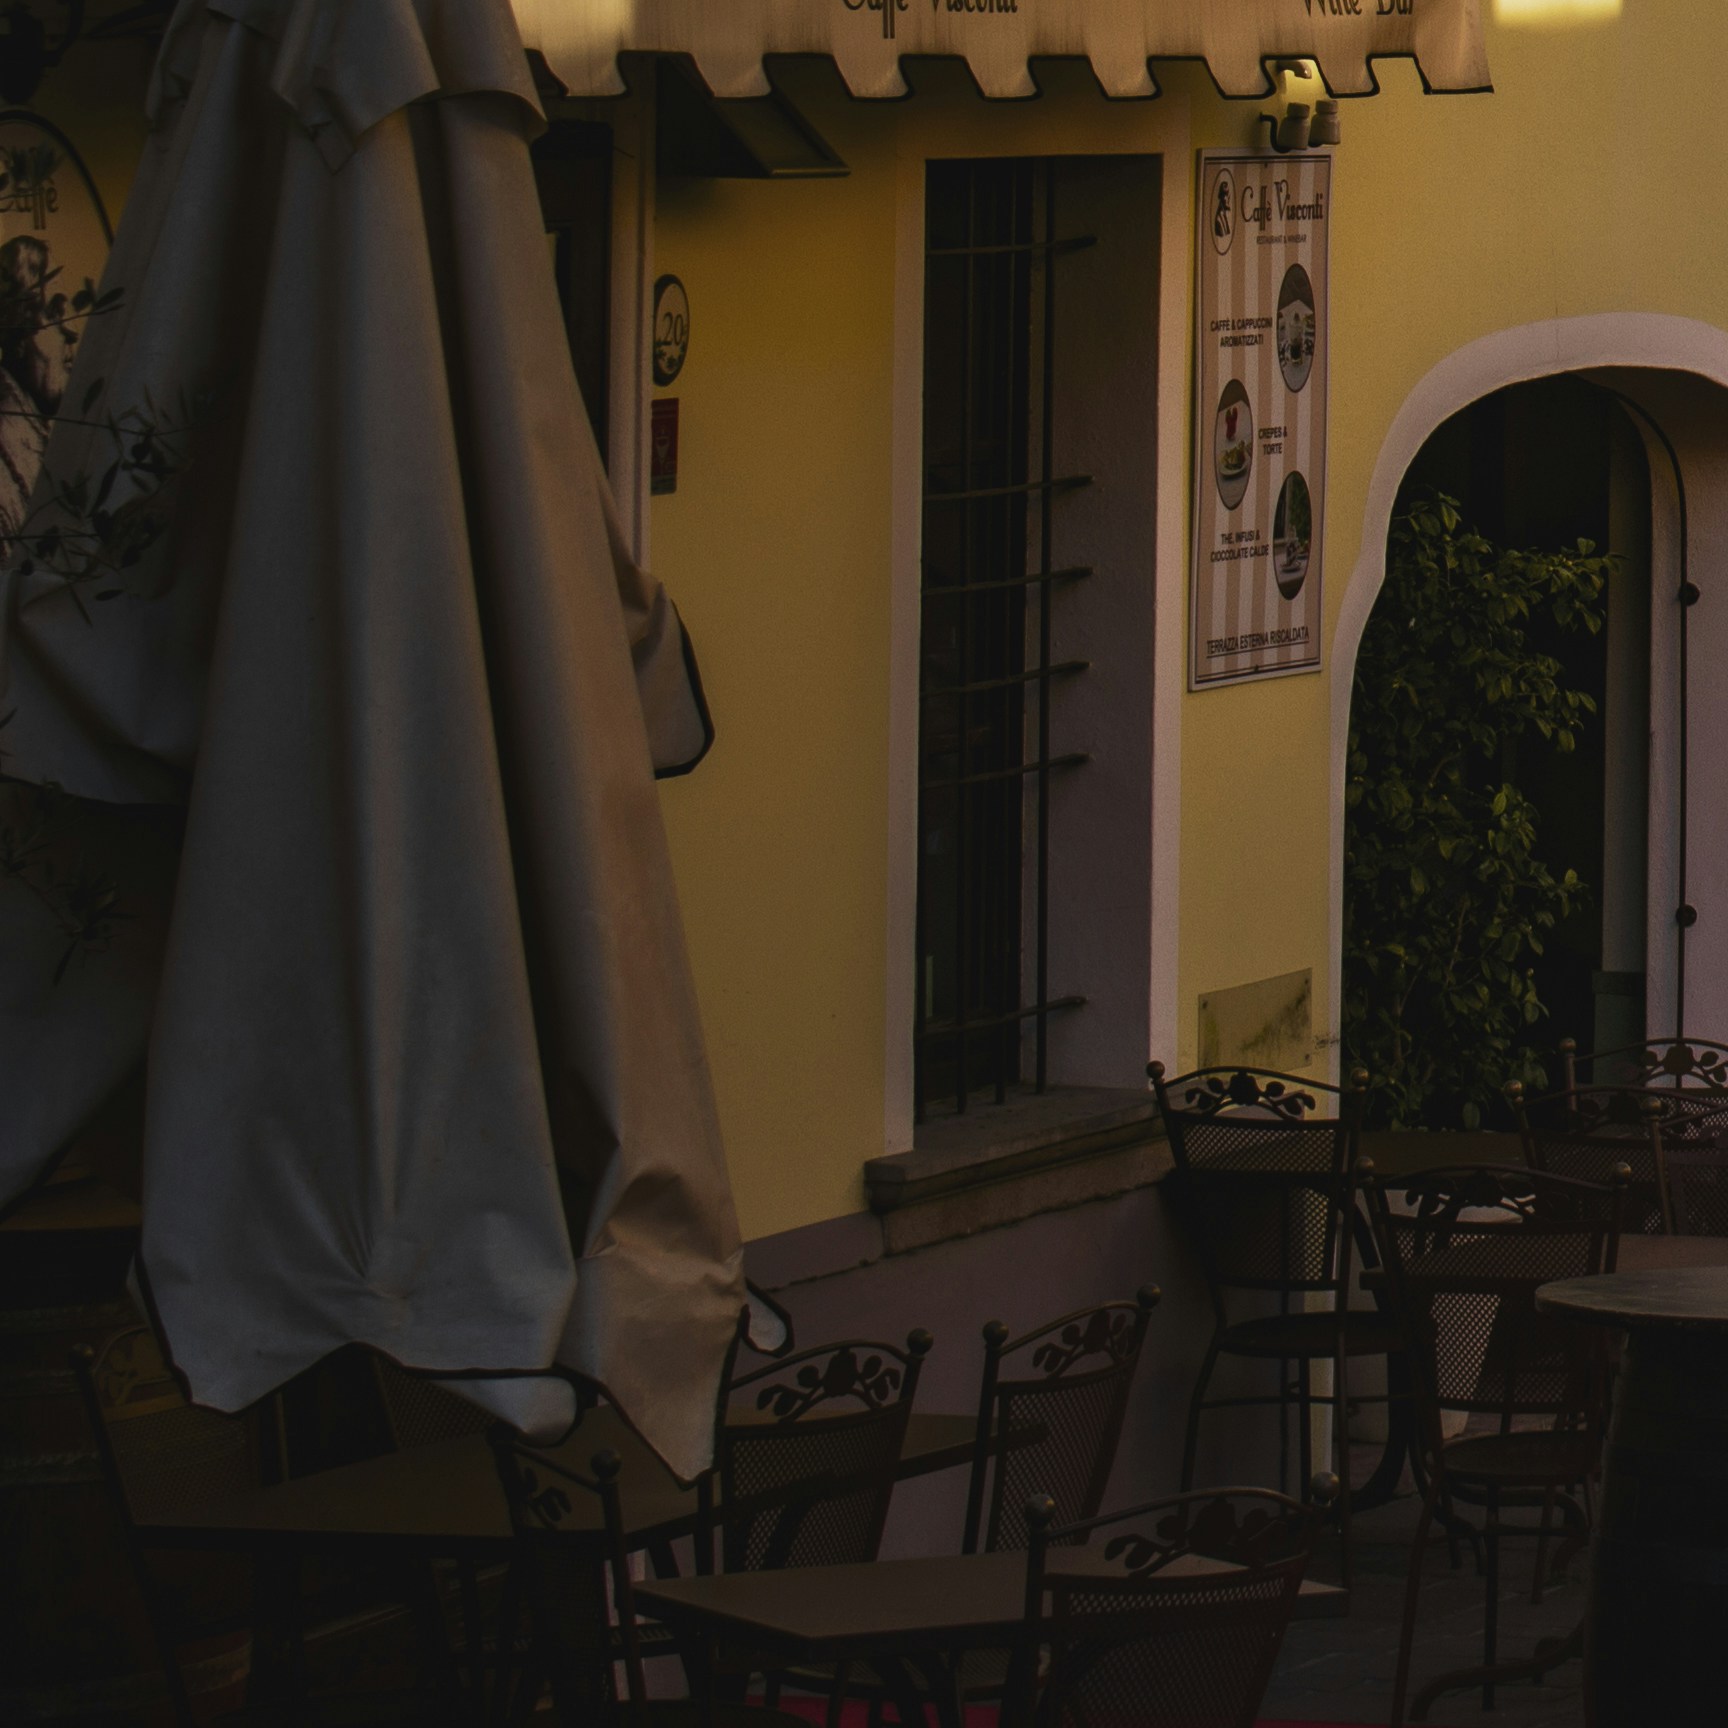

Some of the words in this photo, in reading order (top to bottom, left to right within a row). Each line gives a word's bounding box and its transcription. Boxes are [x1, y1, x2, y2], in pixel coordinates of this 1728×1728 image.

[1241, 184, 1272, 231] Caffè
[1274, 179, 1323, 222] Visconti
[1220, 334, 1264, 347] AROMATIZZATI
[1258, 427, 1282, 439] CREPES
[1263, 443, 1283, 454] TORTE
[1210, 547, 1248, 562] CIOCCOLATE
[1250, 544, 1269, 557] CALDE
[1207, 638, 1239, 654] TERRAZZA
[1240, 633, 1269, 649] ESTERNA
[1270, 626, 1309, 645] RISCALDATA
